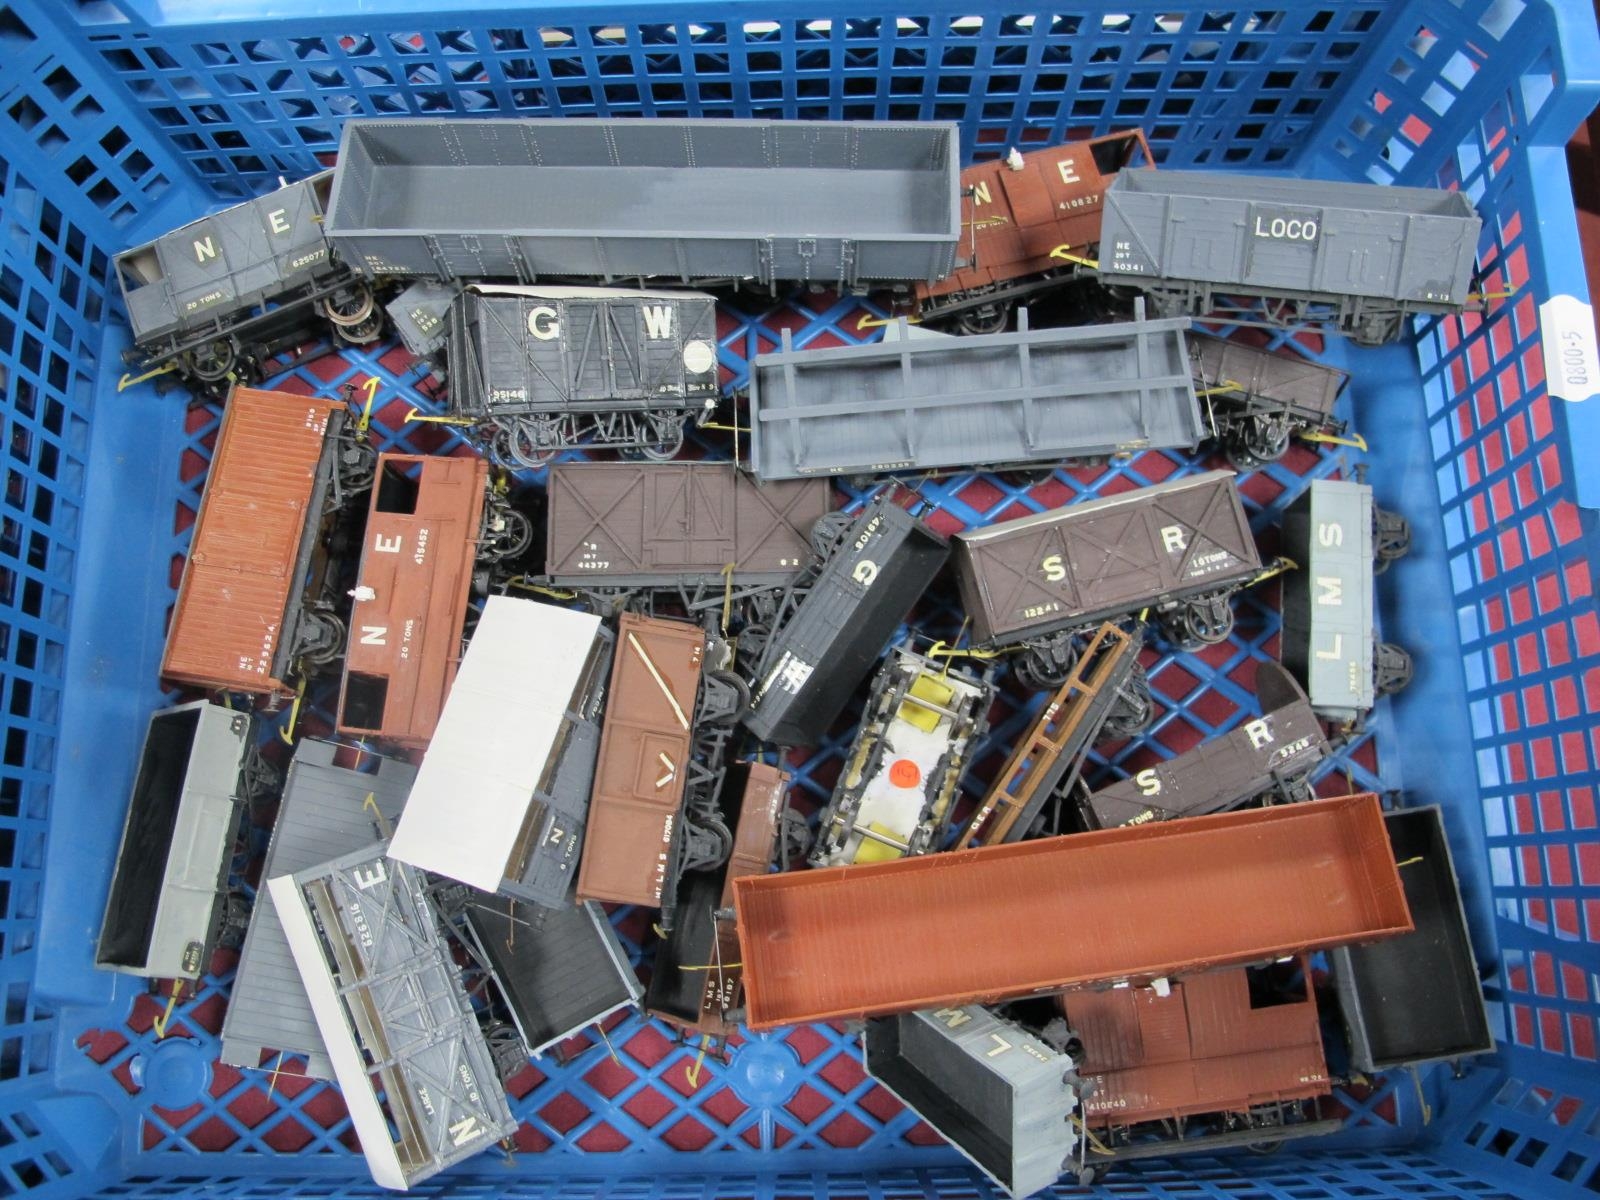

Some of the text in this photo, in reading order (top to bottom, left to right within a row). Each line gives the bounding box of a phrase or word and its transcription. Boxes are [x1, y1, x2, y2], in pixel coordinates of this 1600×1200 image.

[969, 159, 1080, 206] N E
[193, 208, 290, 262] N E
[1255, 216, 1317, 241] LOCO
[292, 249, 325, 268] 625077
[200, 291, 222, 305] TONS
[528, 306, 672, 340] G W
[1042, 526, 1187, 582] S R
[852, 559, 879, 586] G
[360, 534, 402, 645] N E
[403, 619, 414, 643] TONS
[1136, 719, 1274, 796] S R
[550, 827, 564, 843] N
[565, 834, 577, 858] TONS
[353, 862, 485, 1147] N E
[984, 1033, 1013, 1058] L
[458, 1064, 479, 1102] 10 TONS
[418, 1087, 435, 1115] LARGE
